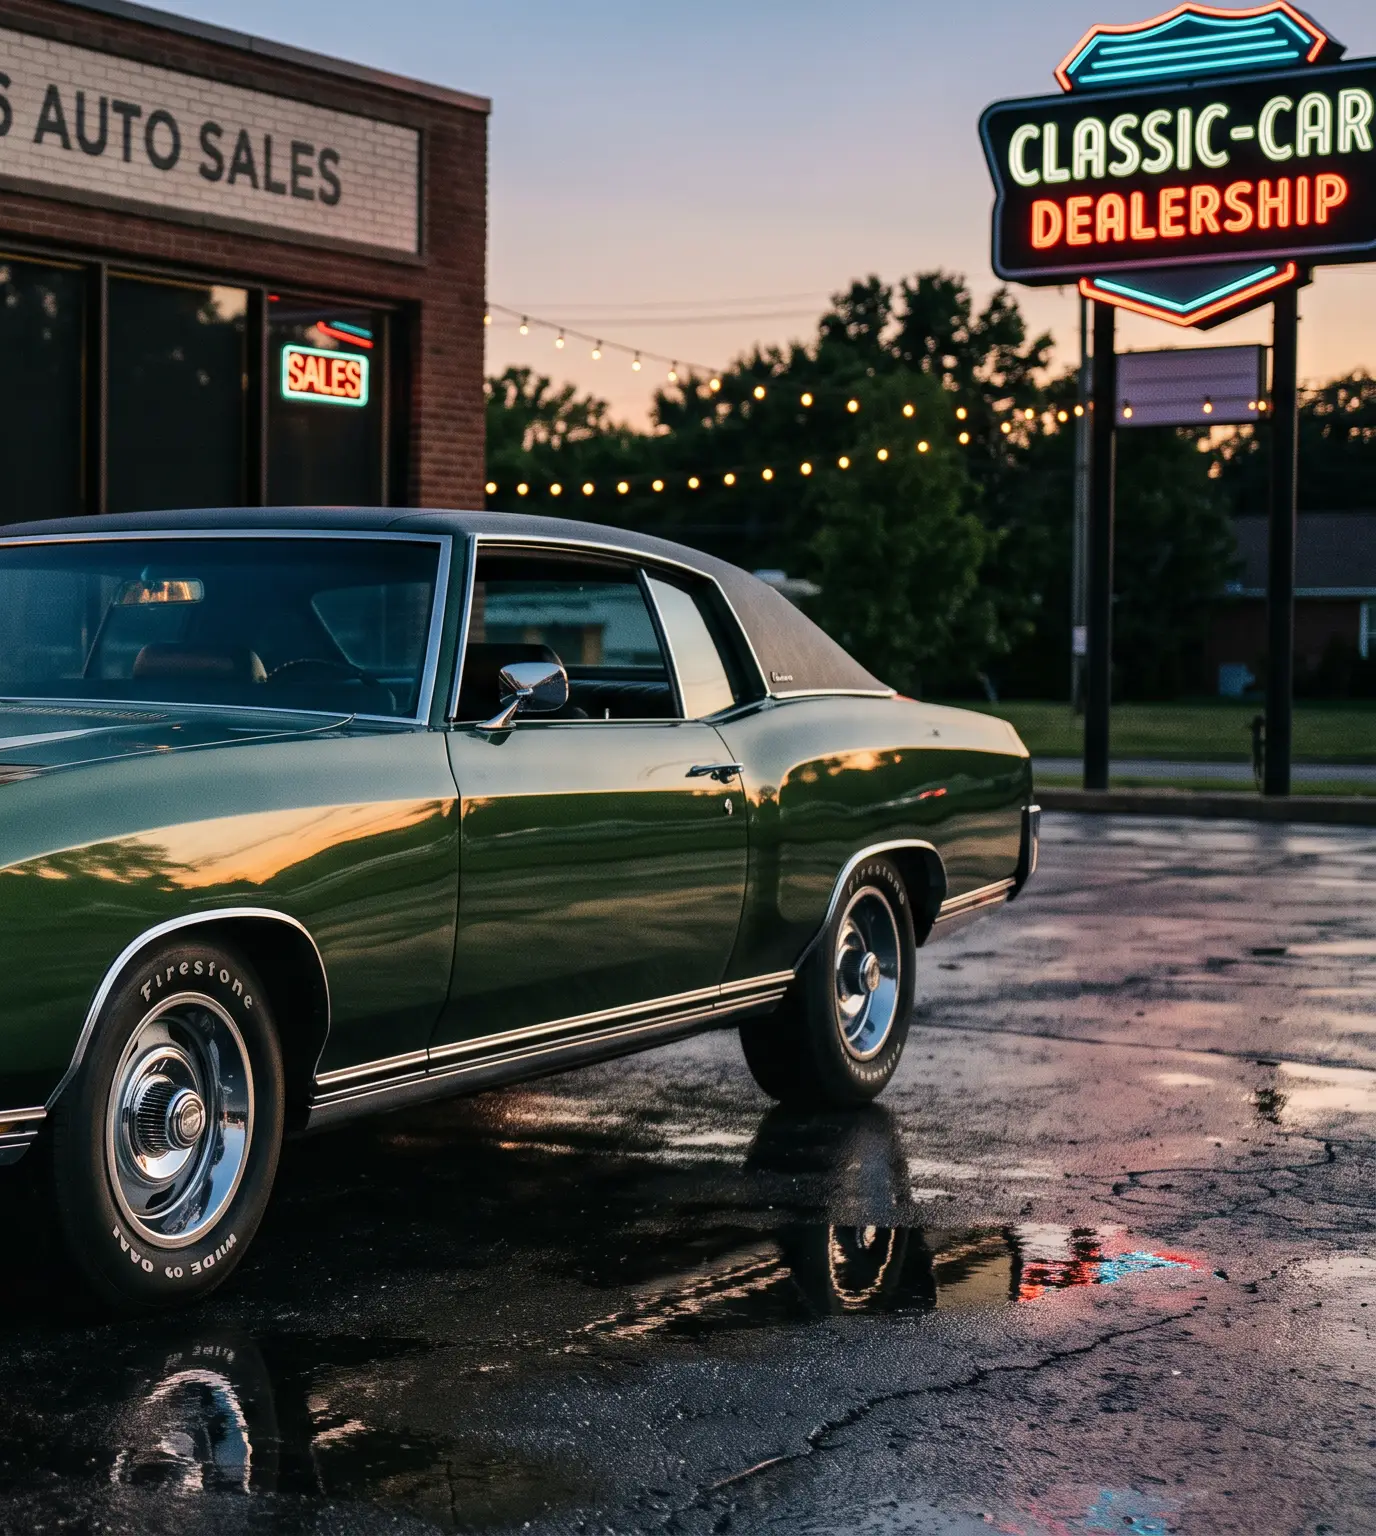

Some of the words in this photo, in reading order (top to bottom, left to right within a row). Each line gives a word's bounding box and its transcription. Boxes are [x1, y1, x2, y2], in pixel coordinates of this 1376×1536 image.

[33, 84, 182, 171] AUTO
[199, 120, 341, 206] SALES
[1008, 88, 1374, 186] CLASSIC-CAR
[1031, 173, 1348, 248] DEALERSHIP
[288, 352, 361, 398] SALES
[140, 960, 253, 1009] Firestone
